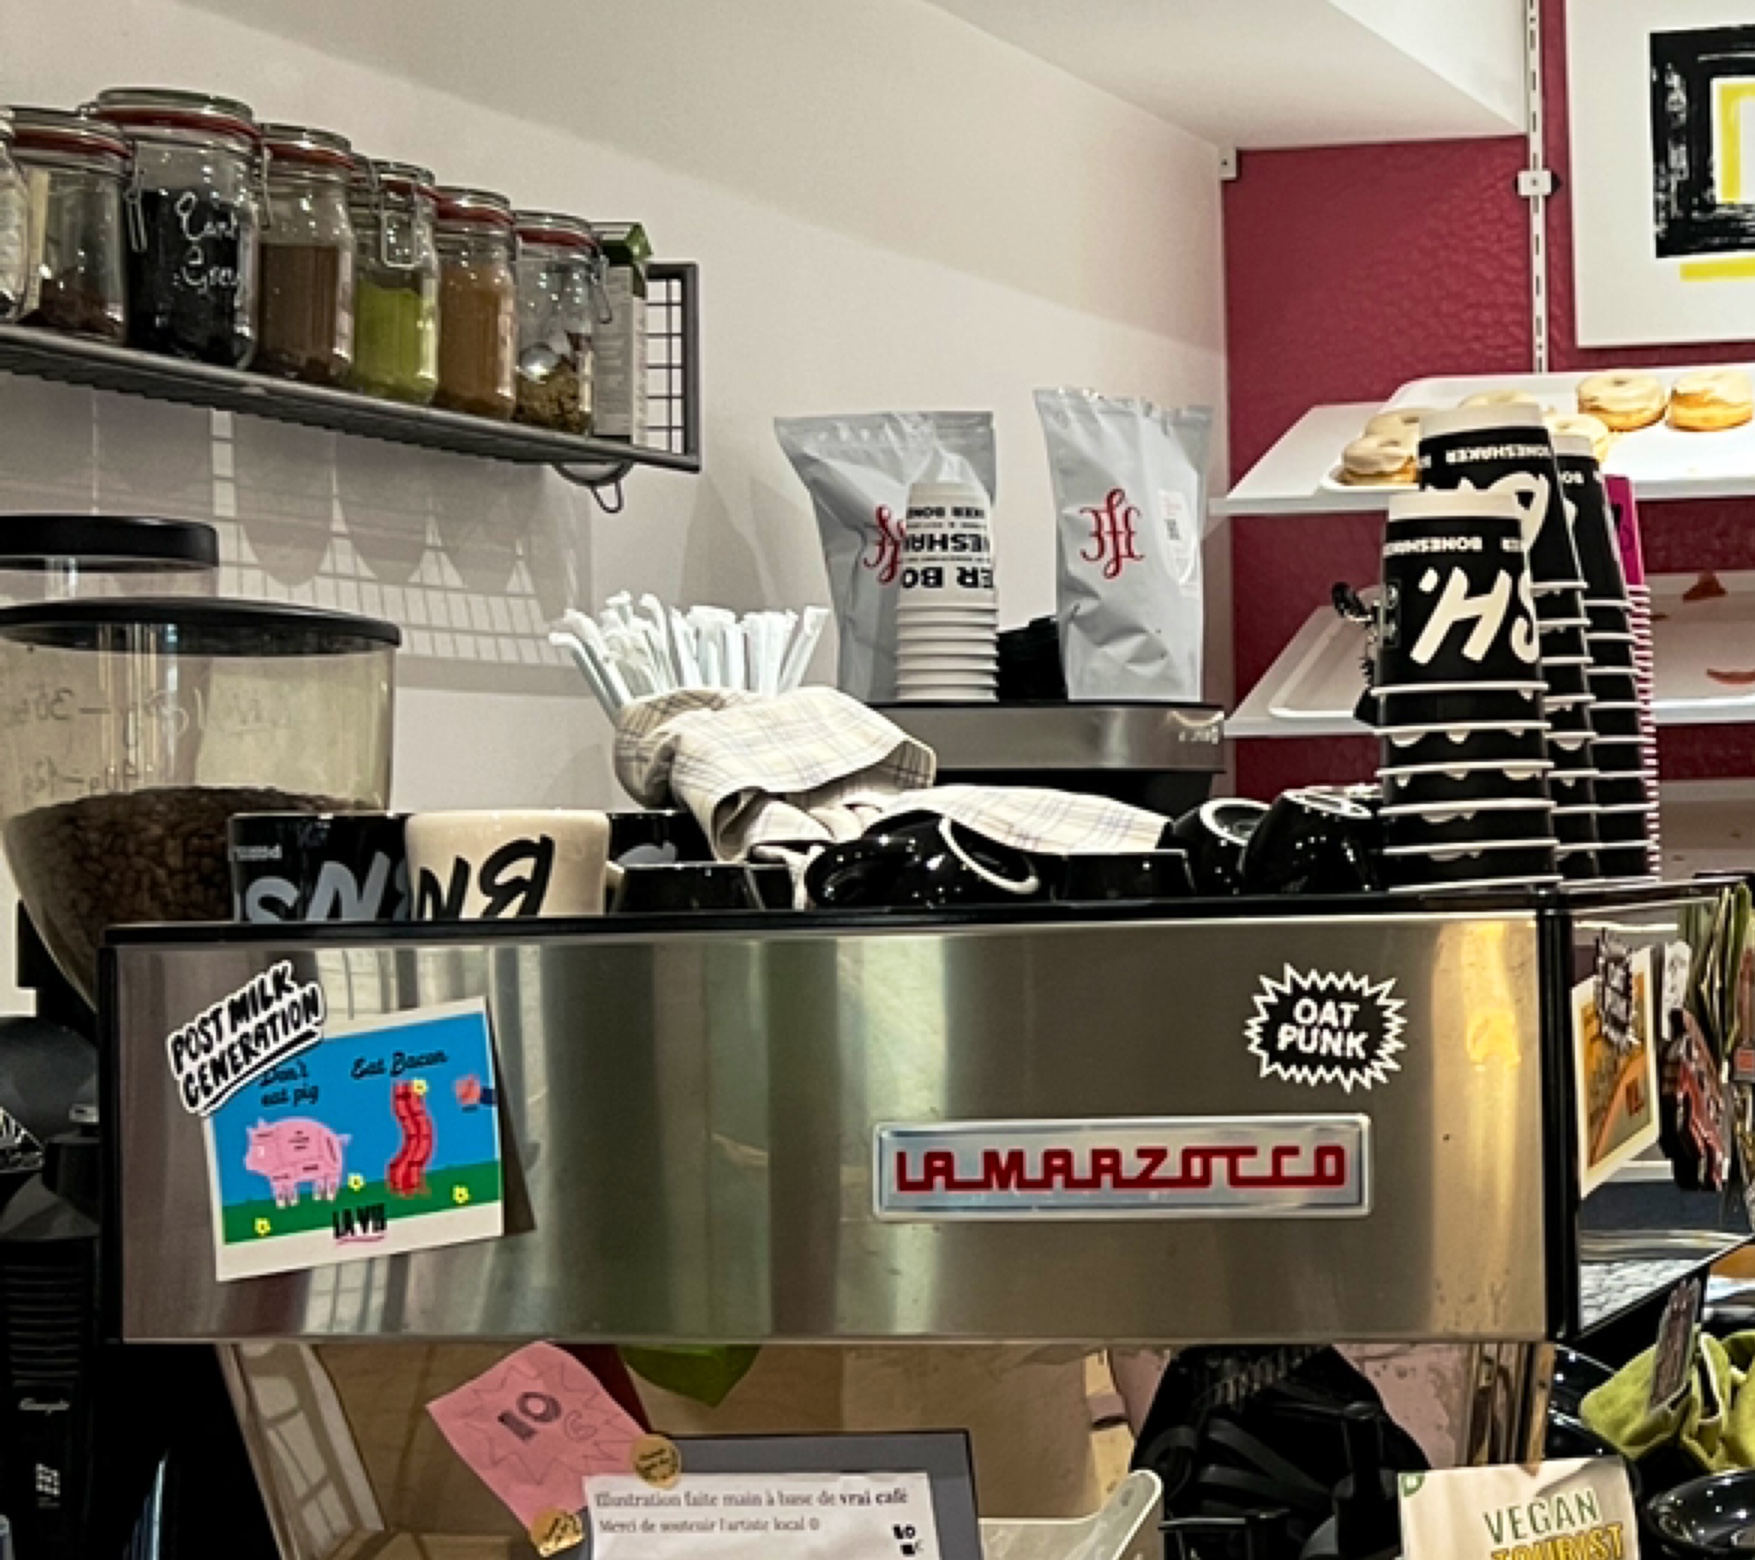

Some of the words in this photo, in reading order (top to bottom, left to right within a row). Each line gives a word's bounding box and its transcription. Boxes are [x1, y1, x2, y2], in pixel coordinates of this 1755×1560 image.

[171, 1007, 226, 1075] POST
[228, 963, 296, 1036] MILK
[1292, 997, 1361, 1029] OAT
[181, 986, 322, 1109] GENERATION
[1277, 1024, 1369, 1060] PUNK
[350, 1055, 386, 1080] Eat
[389, 1049, 448, 1077] Bacon
[293, 1085, 319, 1108] pig
[895, 1149, 954, 1193] LA
[980, 1144, 1348, 1192] MARZOCCO
[722, 1492, 763, 1507] main
[818, 1490, 836, 1506] de
[839, 1490, 871, 1505] vrai
[875, 1488, 909, 1505] café
[600, 1519, 637, 1532] Merci
[641, 1517, 655, 1531] de
[773, 1516, 805, 1531] local
[1483, 1489, 1599, 1545] VEGAN
